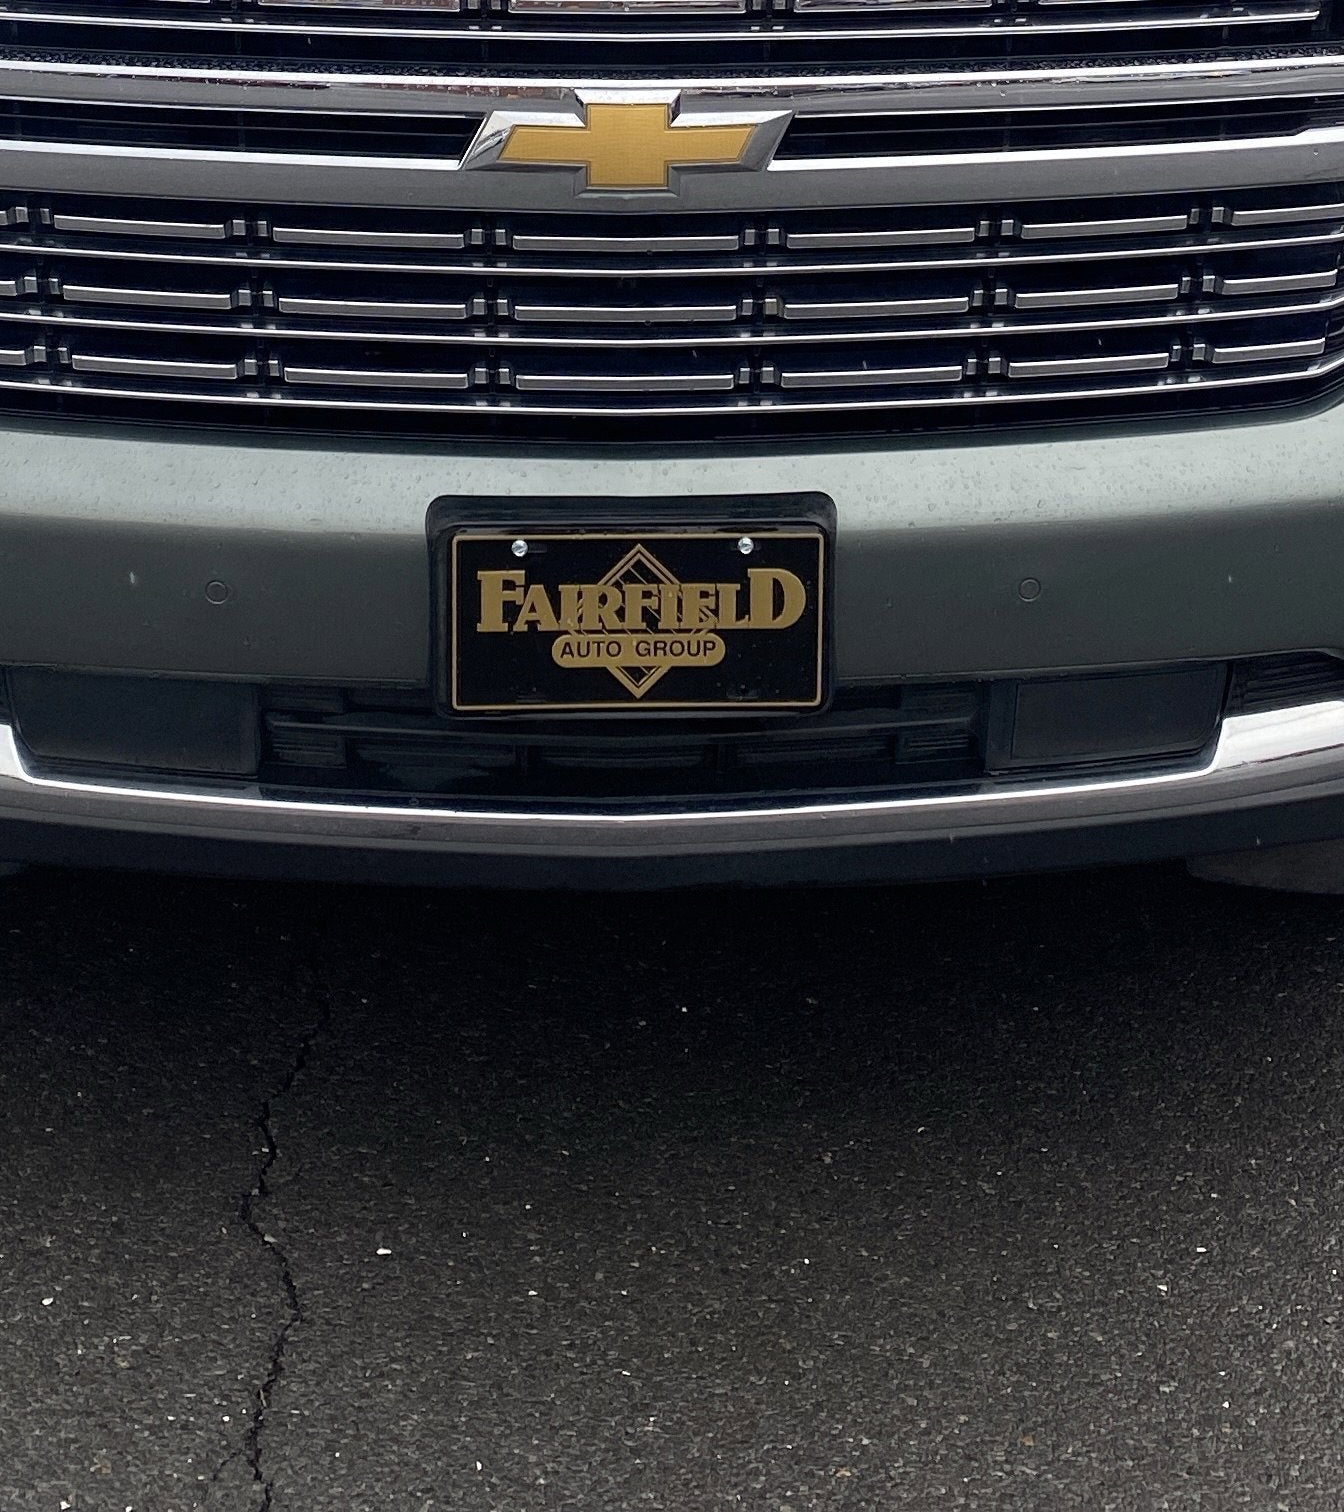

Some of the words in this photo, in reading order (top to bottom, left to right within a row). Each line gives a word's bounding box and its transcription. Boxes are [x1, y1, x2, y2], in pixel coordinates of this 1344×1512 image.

[476, 568, 807, 633] FAIRFIELD
[560, 640, 622, 659] AUTO
[635, 639, 717, 658] GROUP
